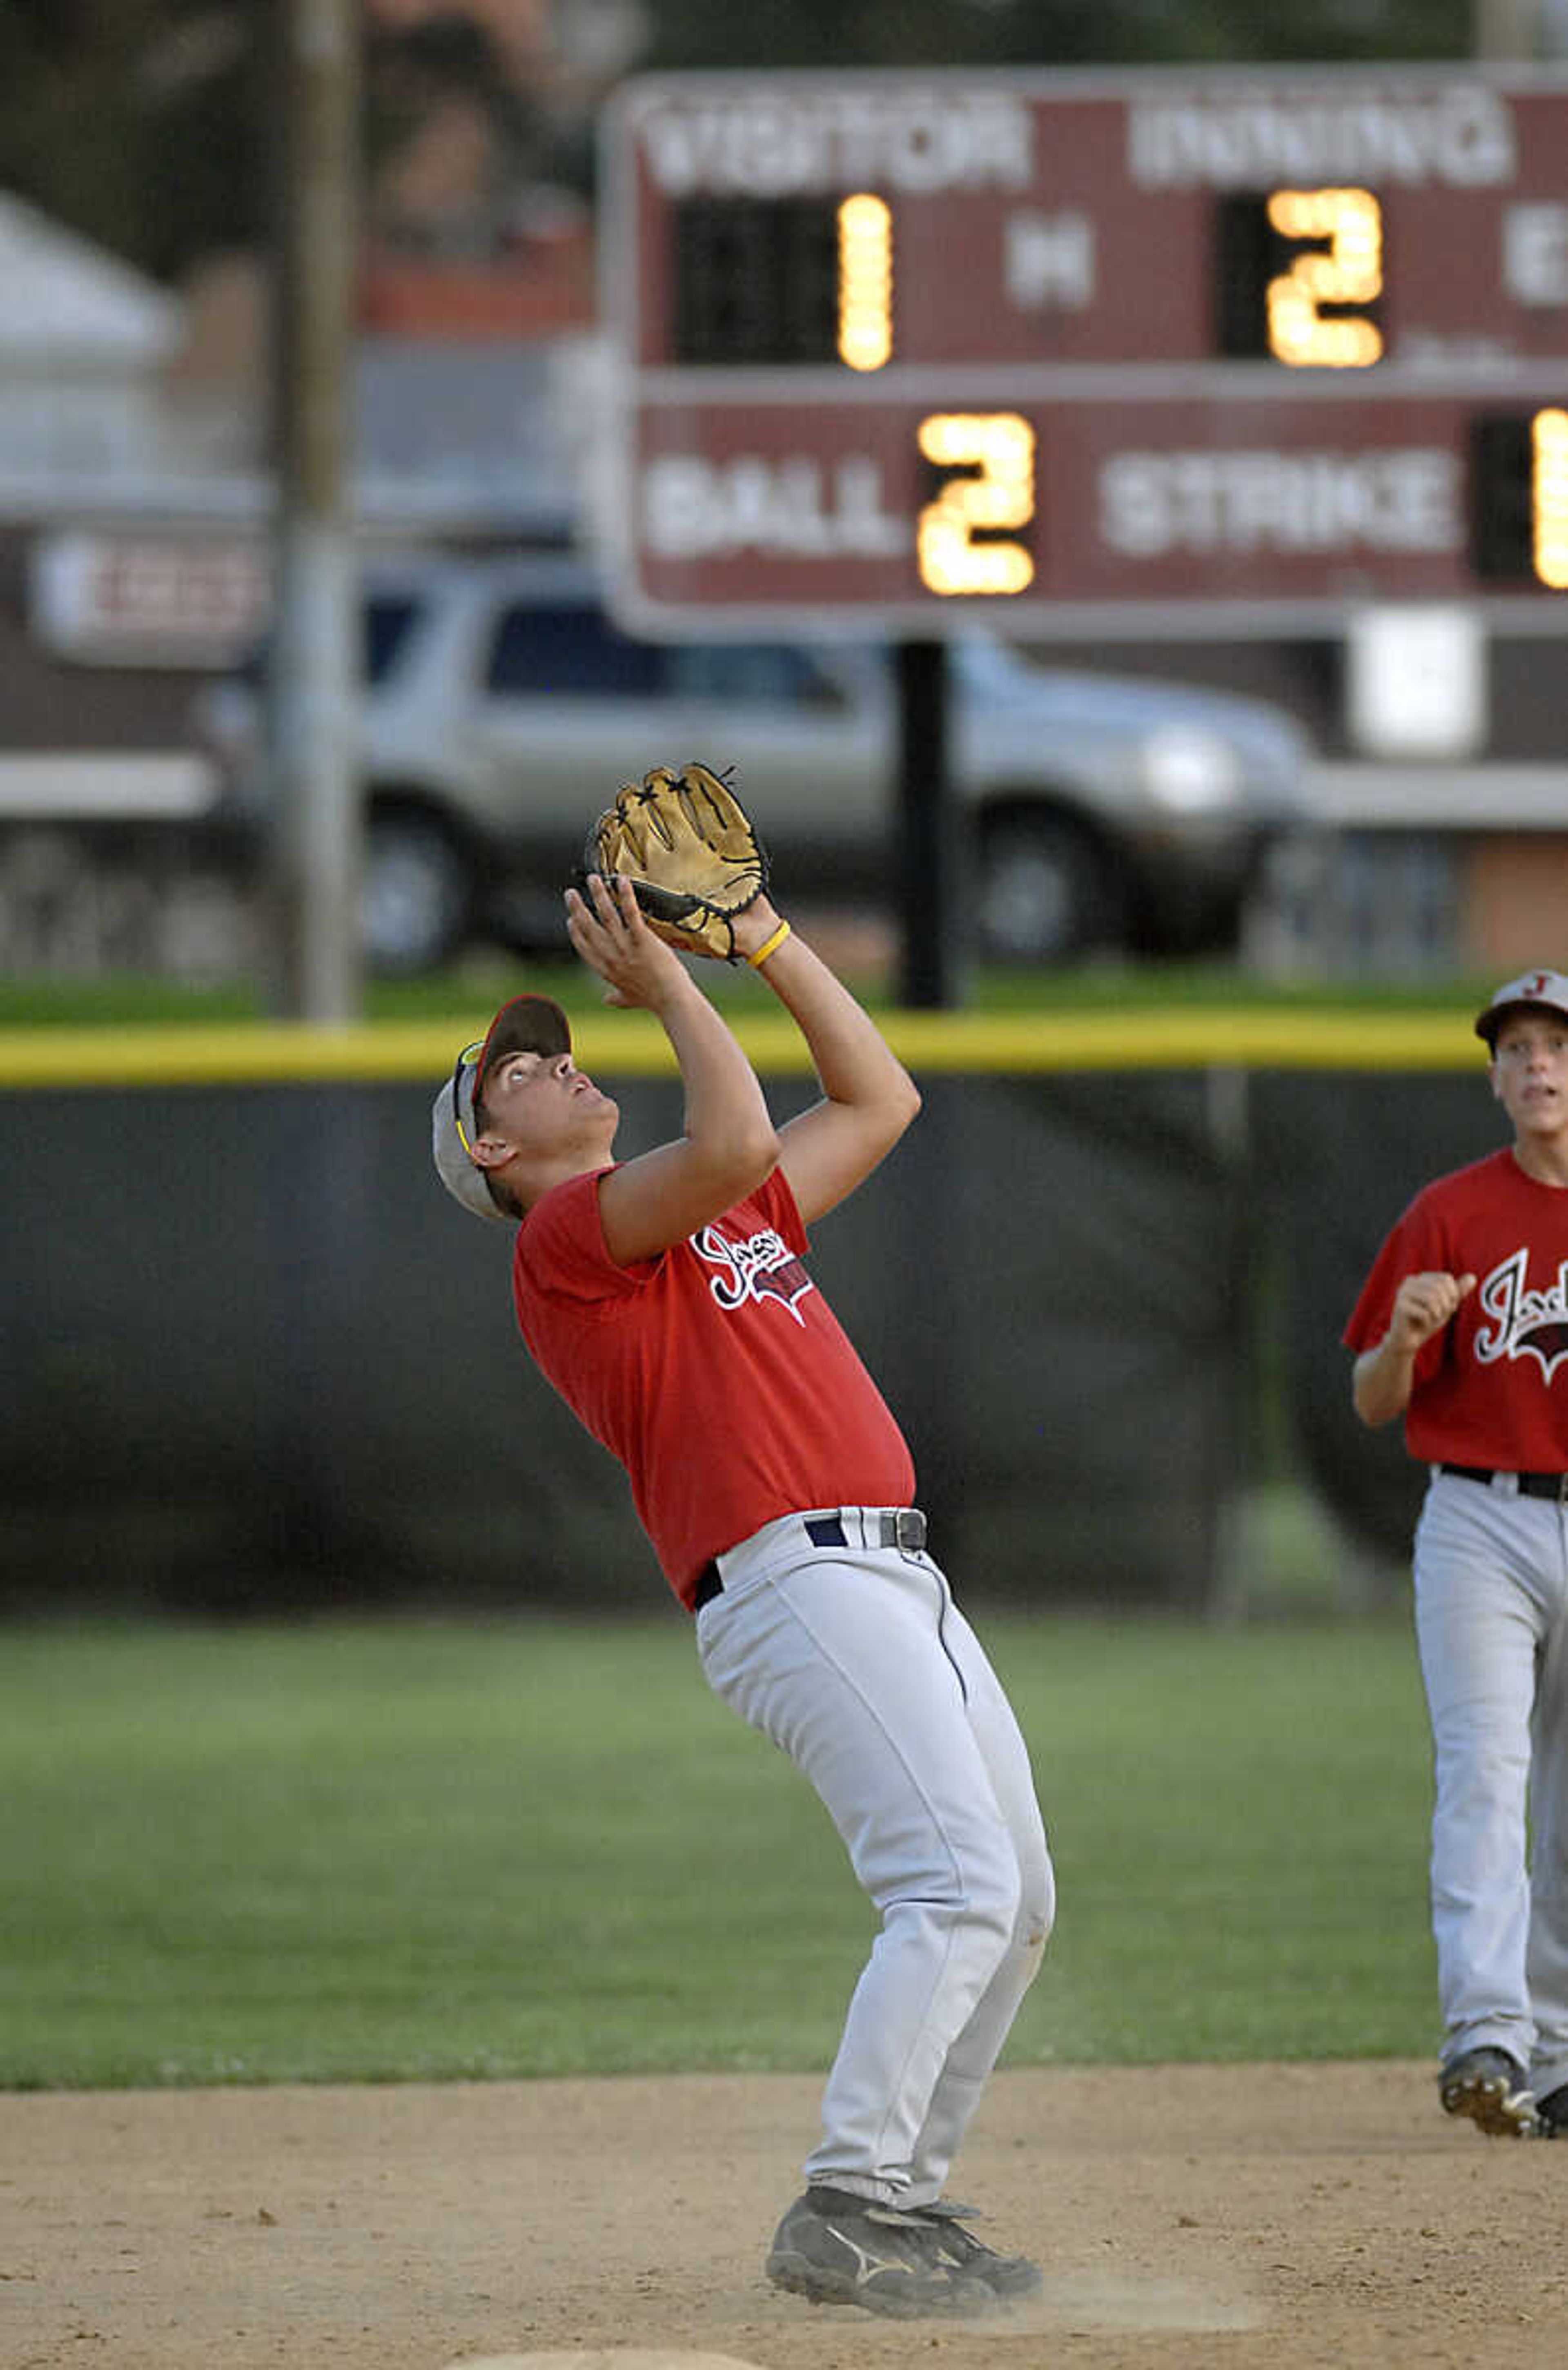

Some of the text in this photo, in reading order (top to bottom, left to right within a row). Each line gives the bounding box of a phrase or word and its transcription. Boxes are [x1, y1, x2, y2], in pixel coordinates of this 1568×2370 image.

[645, 92, 1512, 194] VISITOR INNING
[838, 193, 891, 371] 1
[1002, 212, 1091, 312] H
[1266, 188, 1383, 368] 2
[648, 455, 914, 560] BALL
[917, 412, 1035, 595] 2
[1099, 447, 1467, 559] STRIKE
